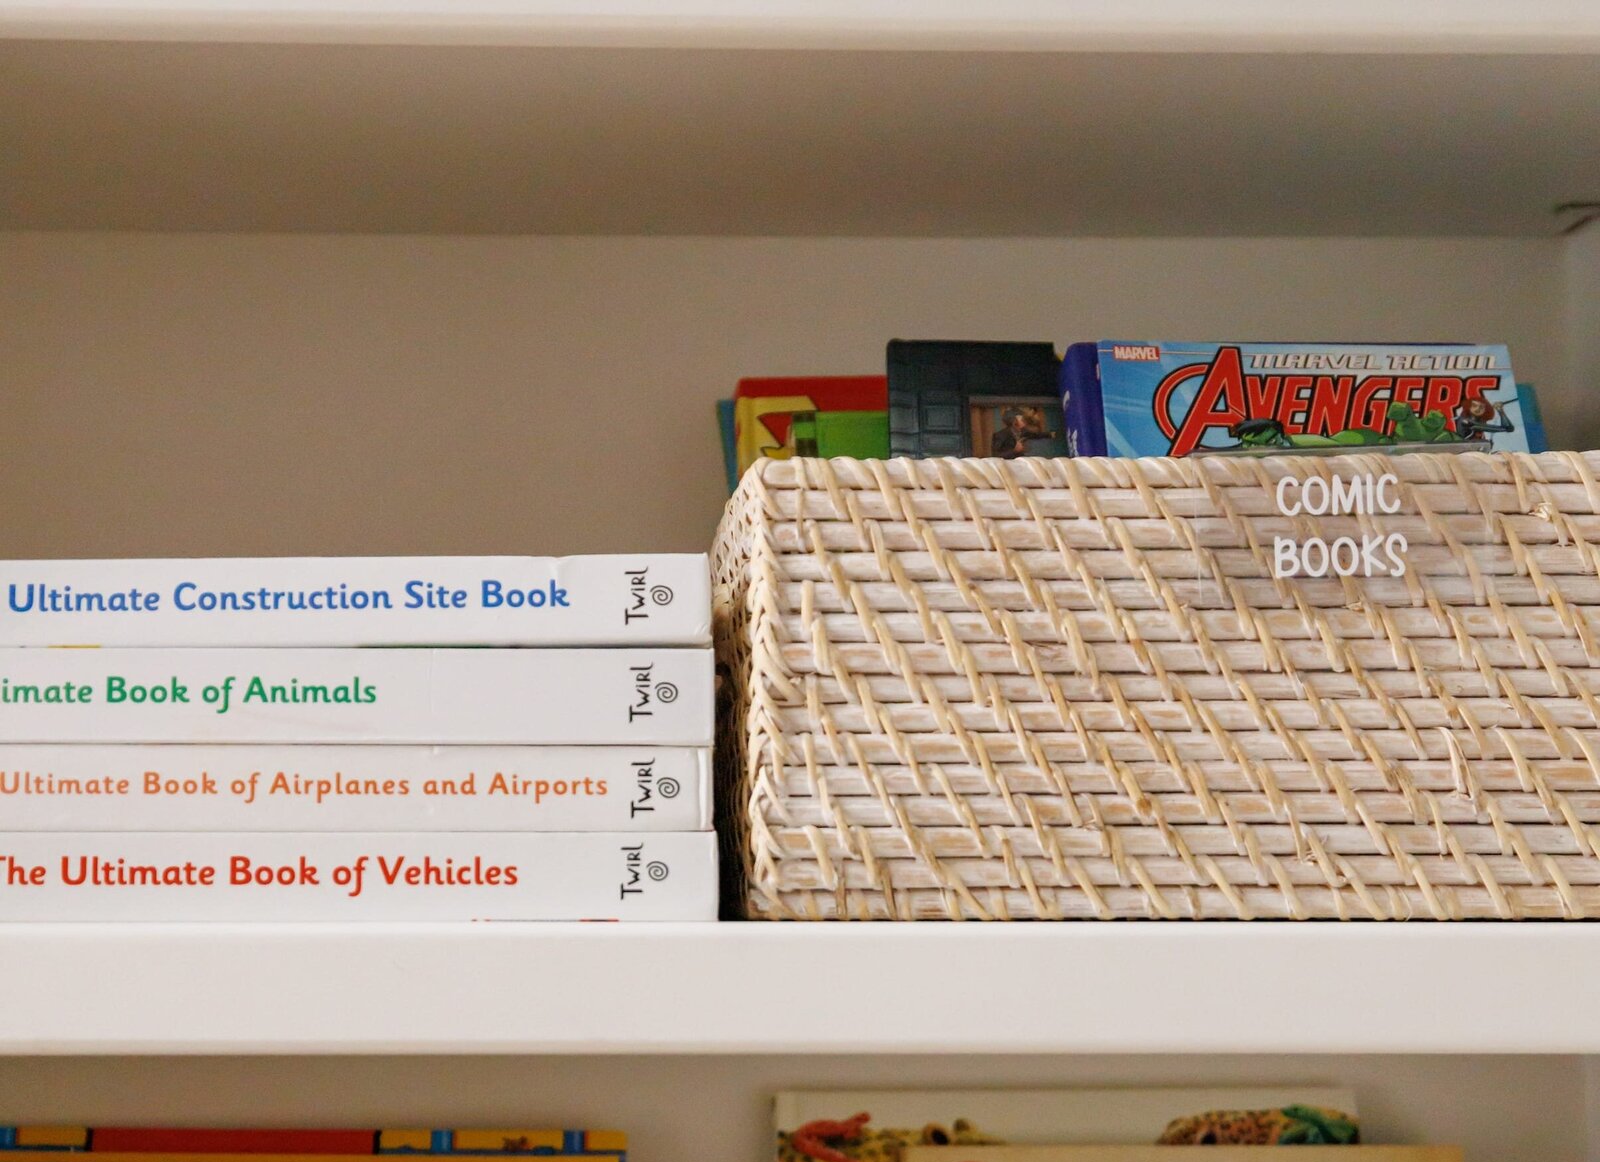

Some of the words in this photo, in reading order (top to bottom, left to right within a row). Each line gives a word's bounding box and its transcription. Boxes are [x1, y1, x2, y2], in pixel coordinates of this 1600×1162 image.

[1113, 346, 1159, 360] MARVEL
[1249, 353, 1382, 370] MARVEL
[1386, 354, 1498, 371] ACTION
[1276, 473, 1401, 517] COMIC
[1273, 535, 1407, 580] BOOKS
[7, 583, 160, 613] Ultimate
[173, 581, 393, 612] Construction
[404, 579, 468, 610] Site
[481, 580, 570, 609] Book
[1, 676, 93, 705] imate
[106, 677, 189, 704] Book
[202, 676, 235, 713] of
[244, 676, 377, 704] Animals
[0, 772, 130, 796] Ultimate
[144, 772, 217, 796] Book
[231, 772, 262, 804] of
[270, 772, 410, 804] Airplanes
[423, 772, 477, 796] and
[488, 772, 609, 804] Airports
[60, 855, 215, 887] Ultimate
[228, 854, 320, 886] Book
[332, 853, 370, 897] of
[376, 855, 519, 886] Vehicles
